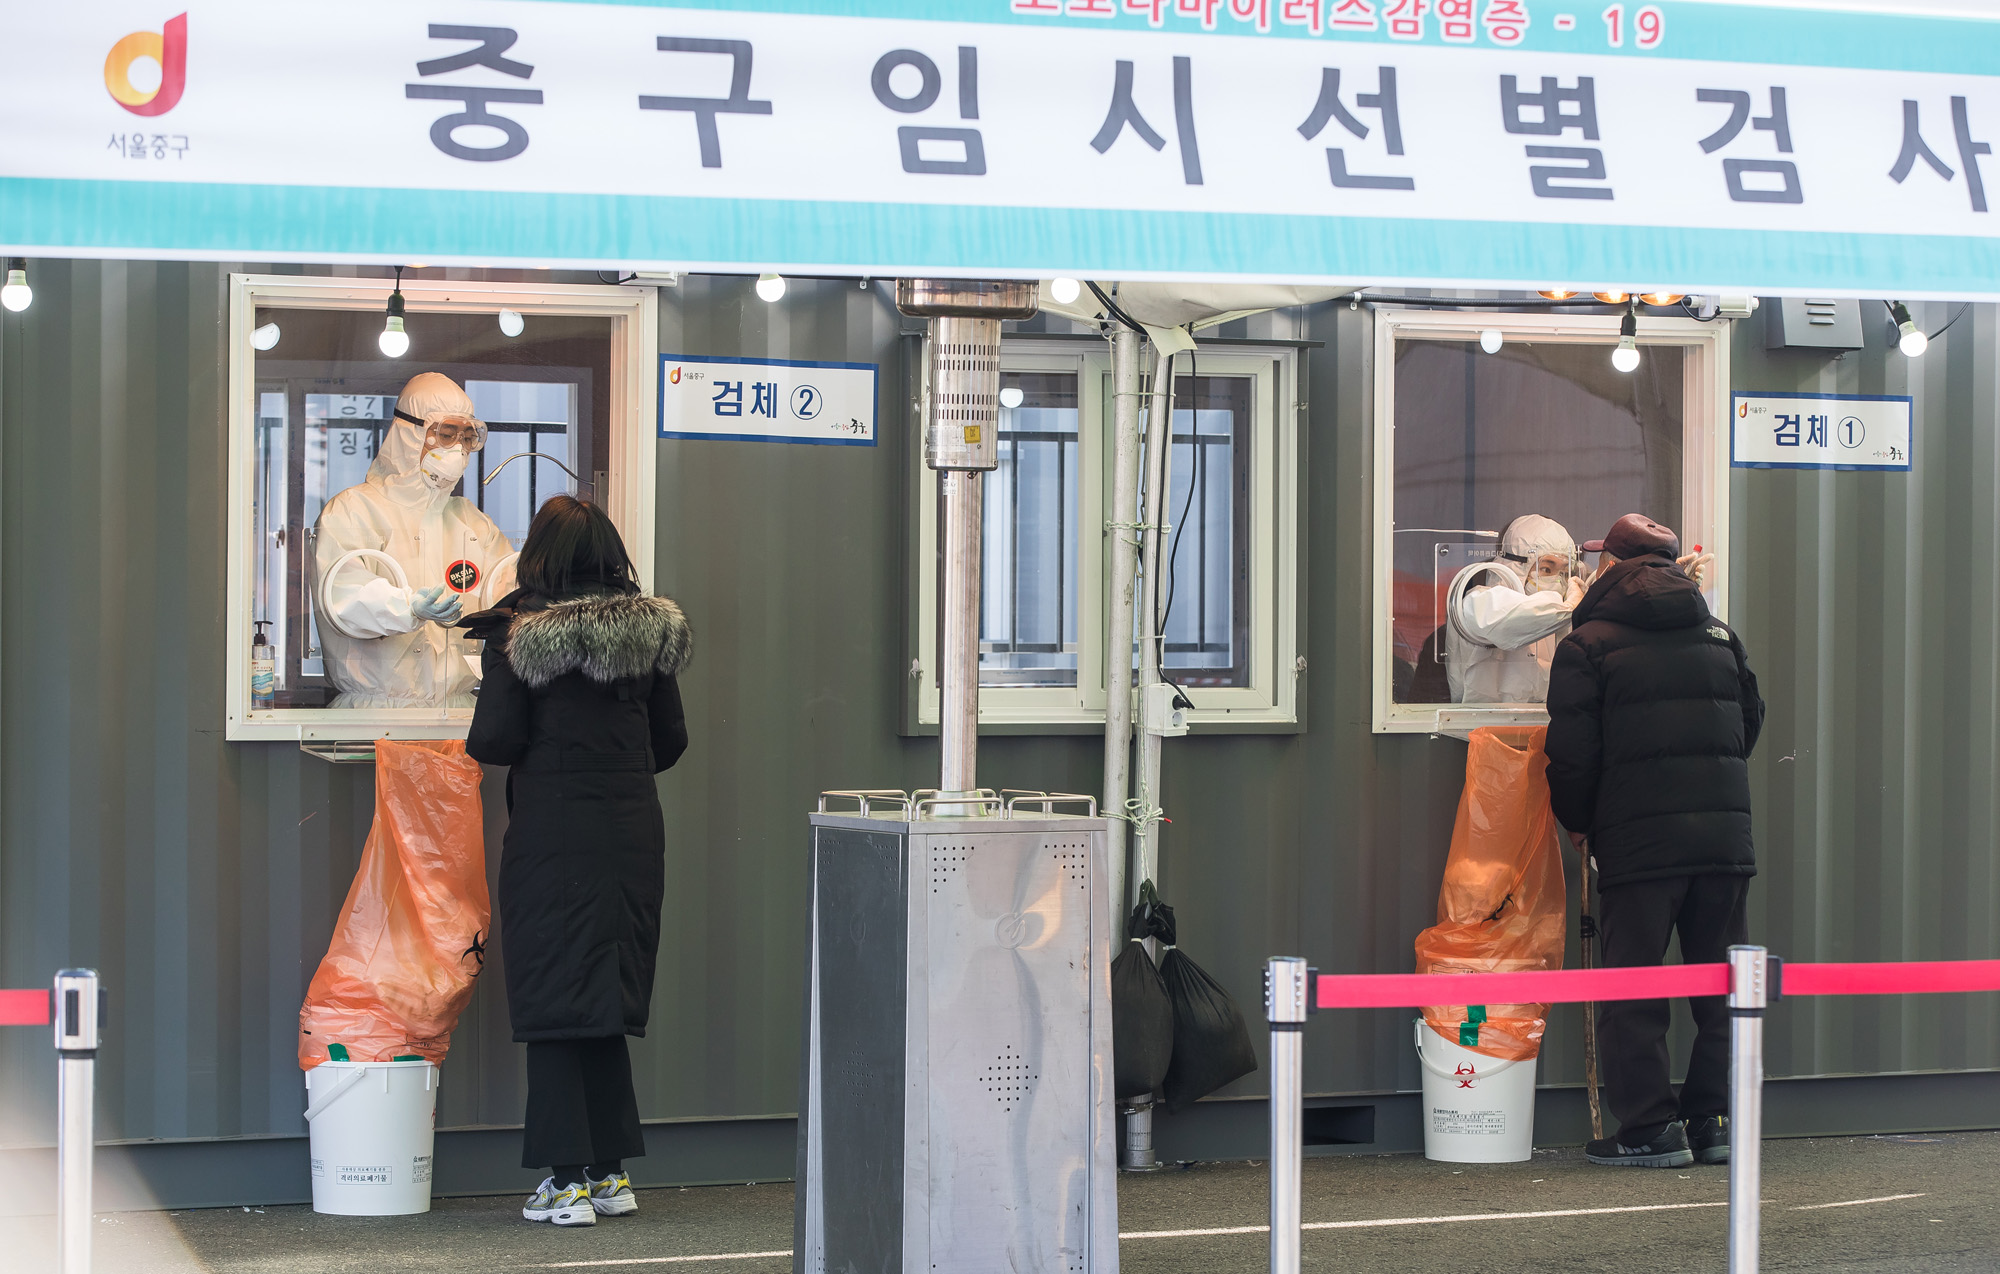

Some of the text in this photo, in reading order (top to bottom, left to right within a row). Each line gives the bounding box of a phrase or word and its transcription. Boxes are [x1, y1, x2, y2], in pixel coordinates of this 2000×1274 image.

[1015, 0, 1525, 40] 나바이러스감염증
[1606, 10, 1660, 44] 19
[107, 133, 190, 160] 서울중구
[712, 381, 777, 419] 검체
[1773, 414, 1828, 448] 검체
